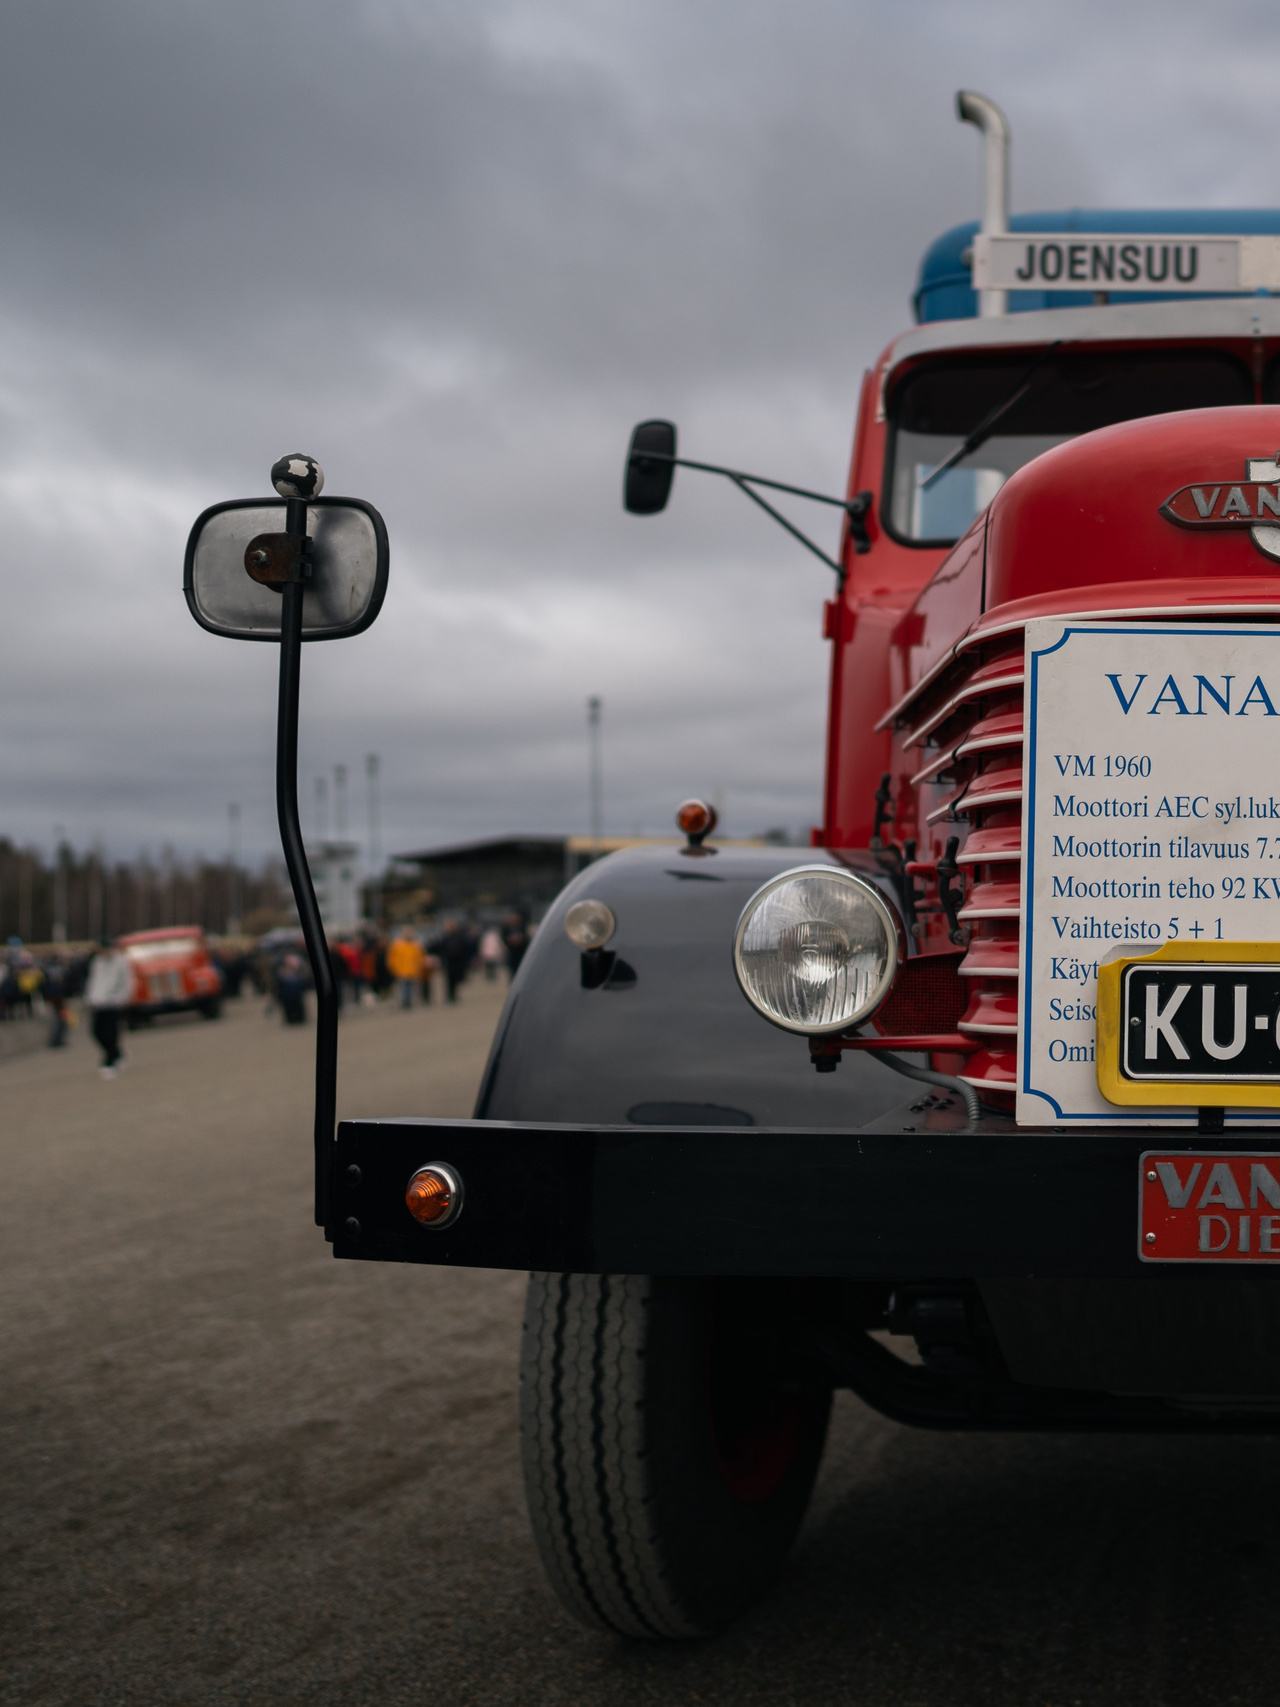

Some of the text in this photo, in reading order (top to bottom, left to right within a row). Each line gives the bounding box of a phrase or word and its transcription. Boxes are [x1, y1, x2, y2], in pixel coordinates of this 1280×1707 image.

[1016, 244, 1199, 283] JOENSUU
[1054, 755, 1152, 778] VM 1960
[1052, 795, 1149, 818] Moottori
[1154, 796, 1209, 819] AEC
[1052, 835, 1162, 858] Moottorin
[1169, 836, 1250, 859] tilavuus
[1051, 876, 1161, 898] Moottorin
[1168, 877, 1215, 899] teho
[1222, 877, 1246, 899] 92
[1051, 916, 1225, 940] Vaihteisto 5 + 1
